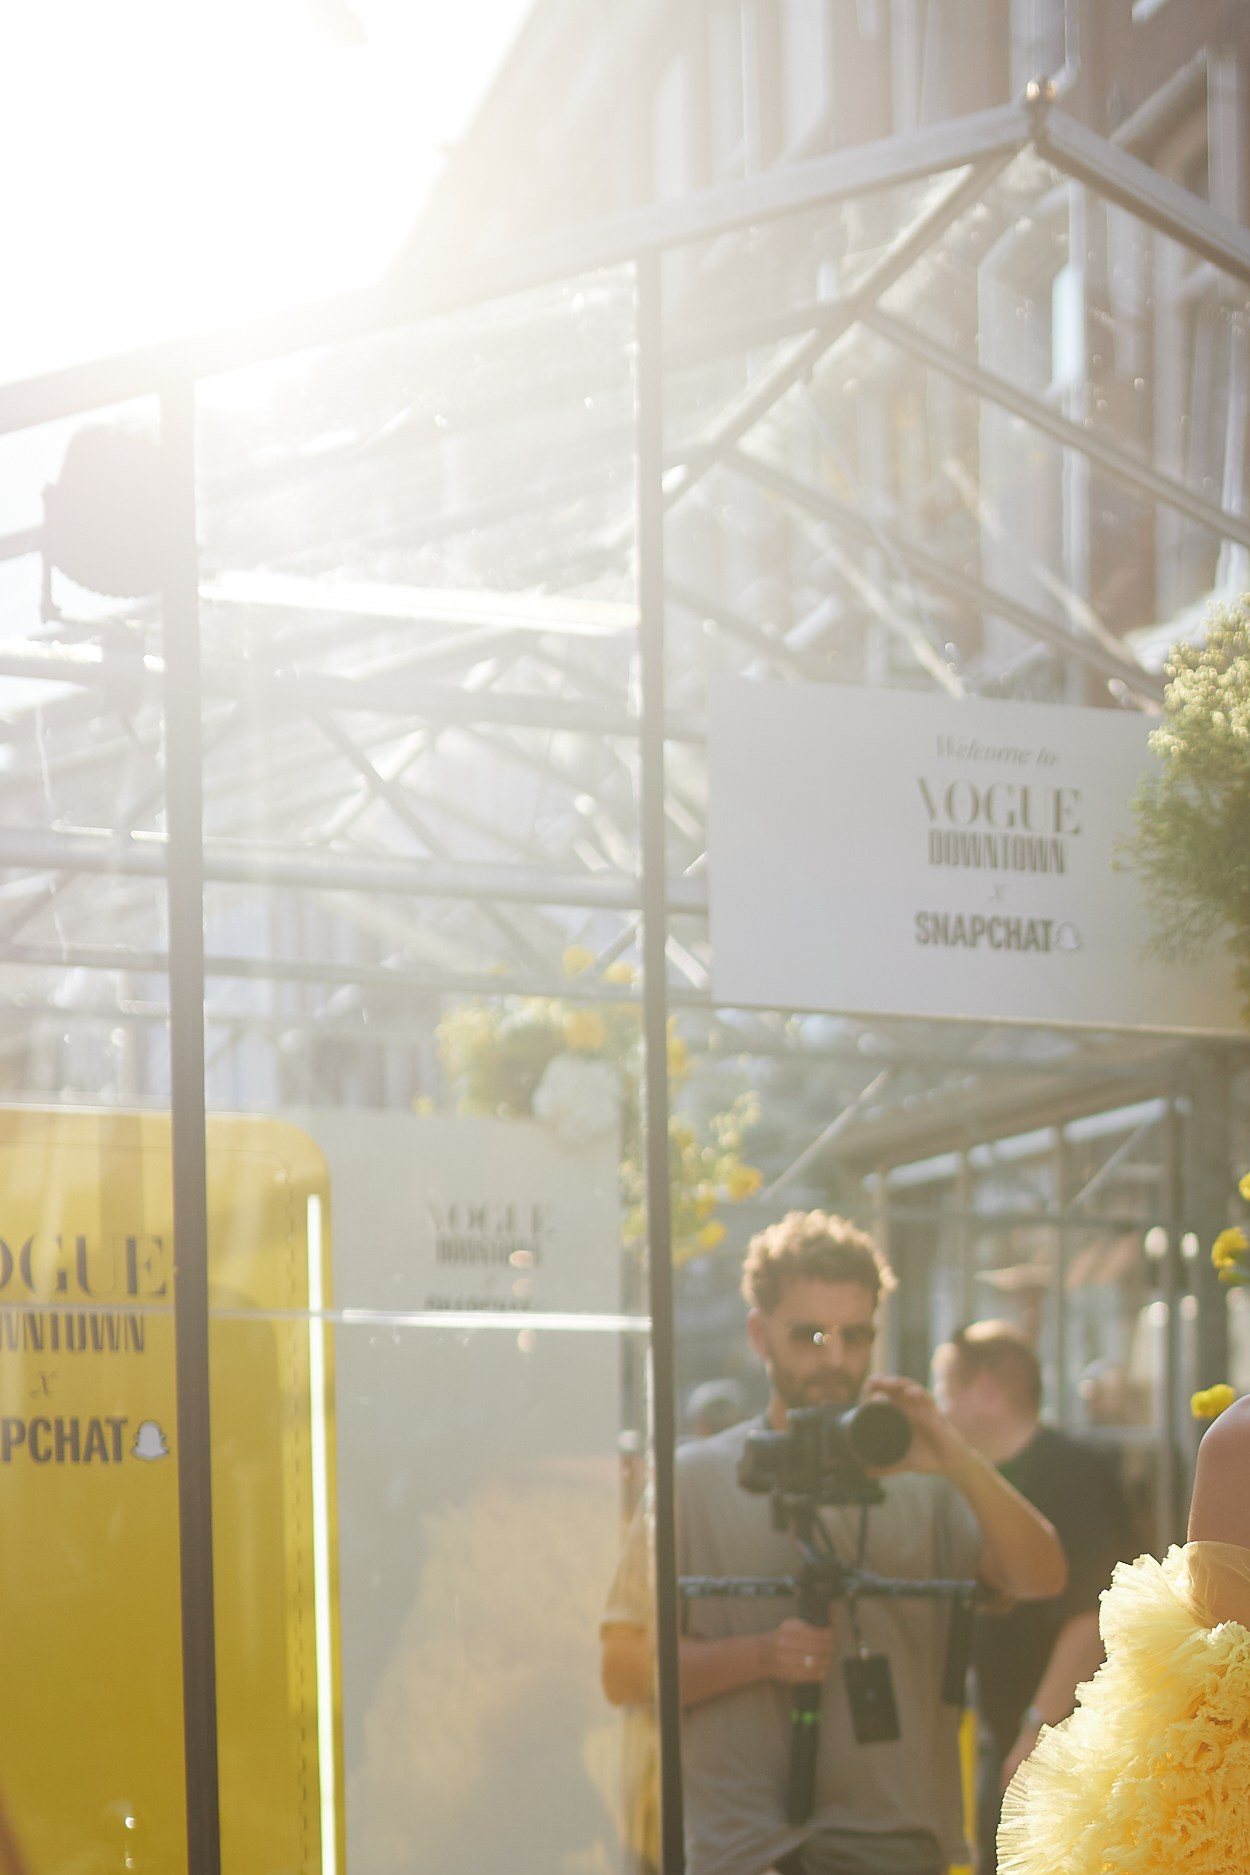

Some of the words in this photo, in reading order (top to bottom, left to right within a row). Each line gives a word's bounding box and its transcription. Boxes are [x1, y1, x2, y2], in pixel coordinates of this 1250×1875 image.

[917, 776, 1083, 836] VOGUE
[928, 828, 1067, 875] DOWNTOWN
[914, 910, 1054, 953] SNAPCHAT
[0, 1234, 167, 1297] GUE
[0, 1415, 128, 1464] PCHAT
